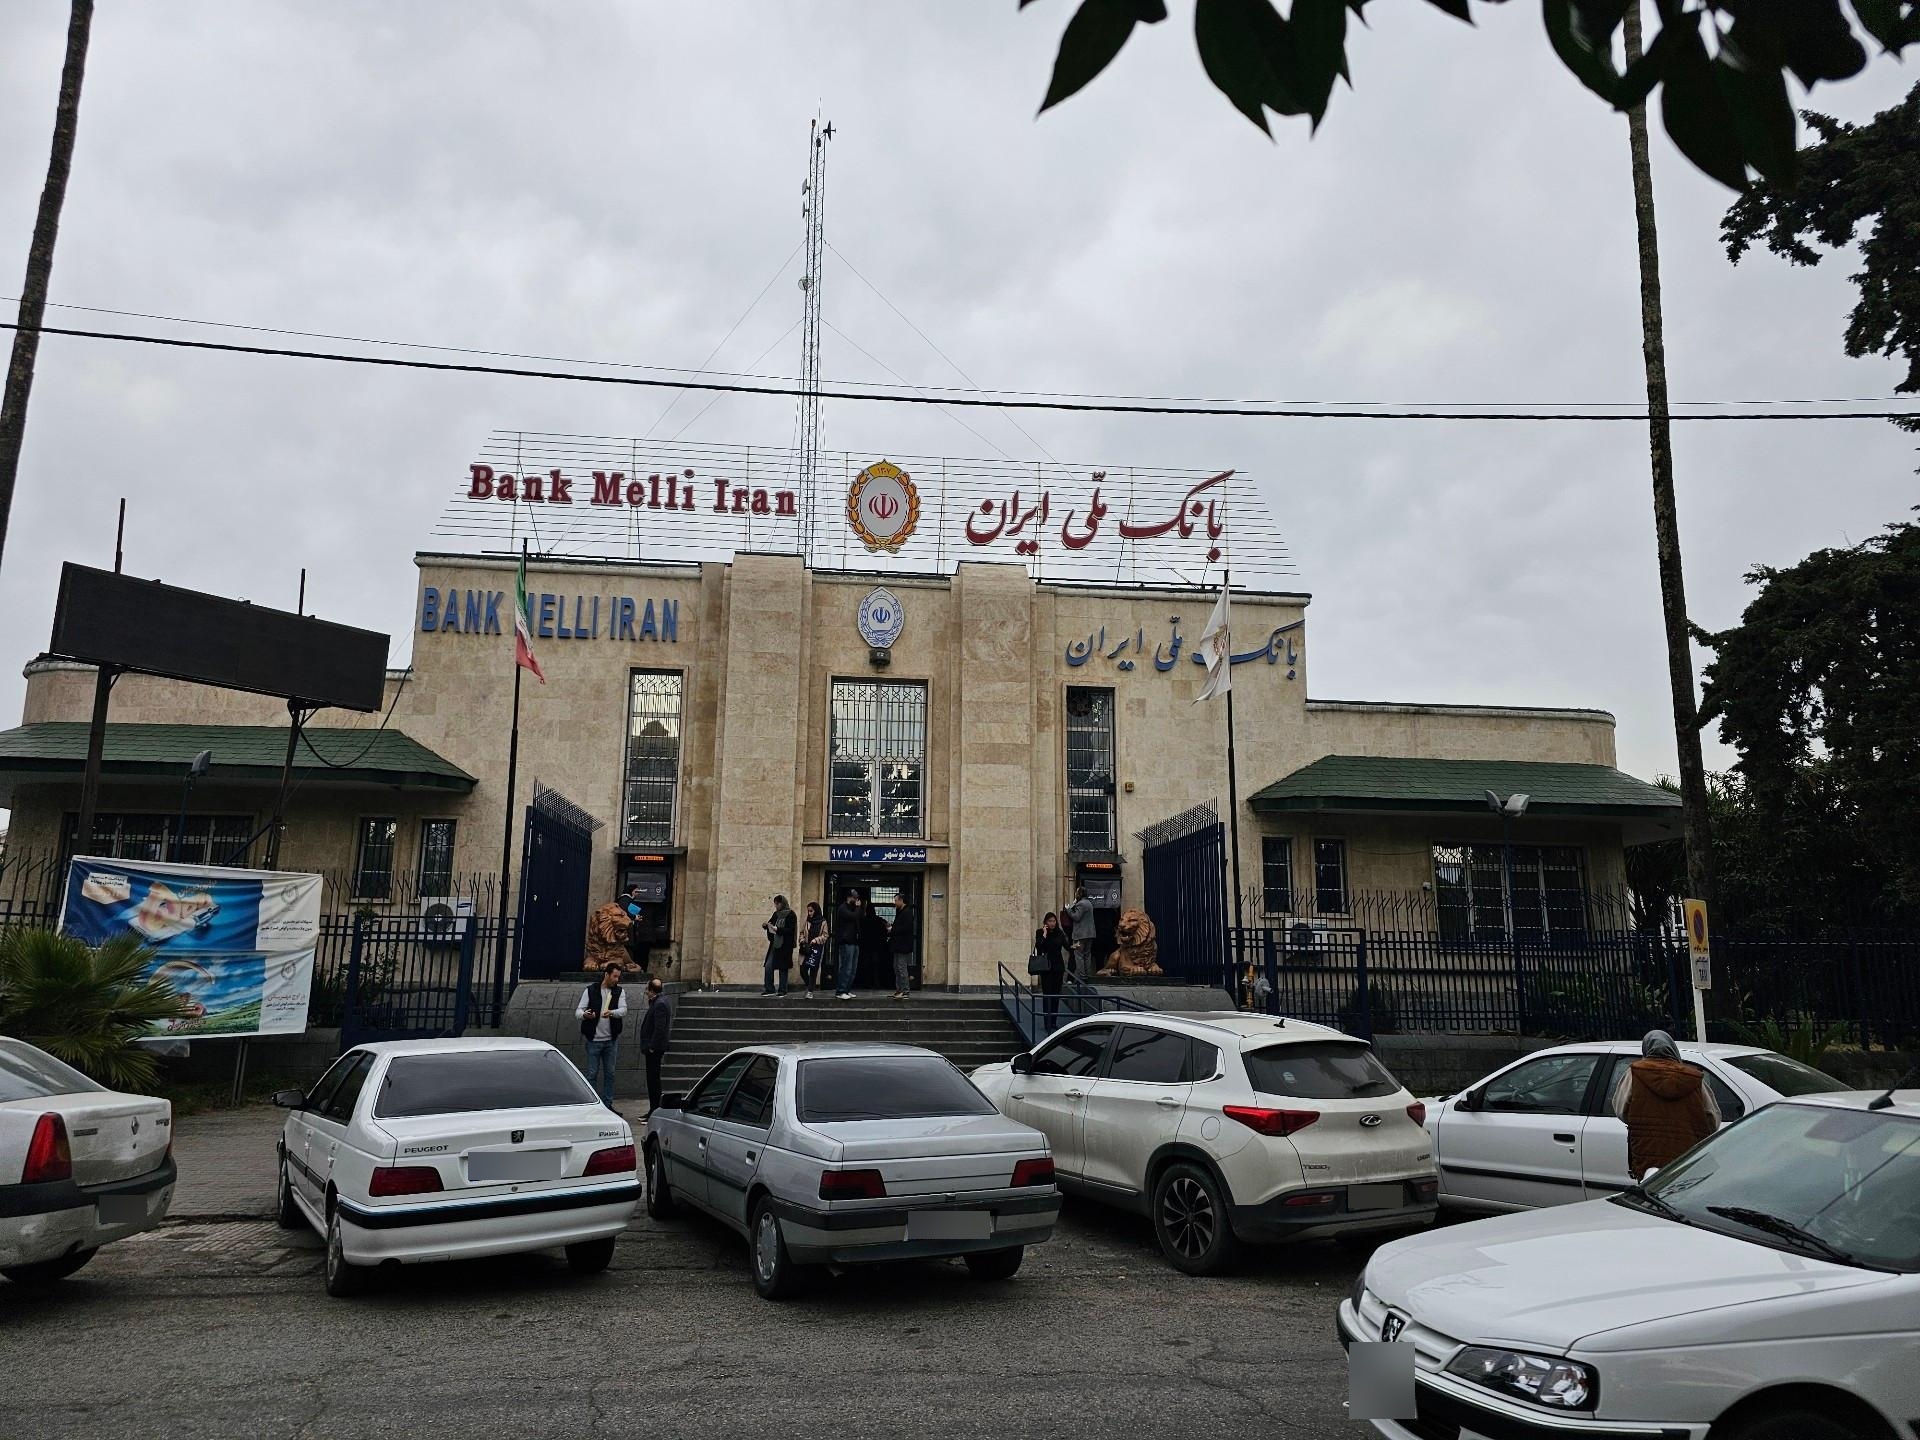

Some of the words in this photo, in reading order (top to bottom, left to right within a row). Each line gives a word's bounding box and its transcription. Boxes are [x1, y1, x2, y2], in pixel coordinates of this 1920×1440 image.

[468, 464, 573, 504] Bank
[590, 468, 695, 511] Melli
[713, 478, 798, 517] Iran
[965, 489, 1050, 555] ایران
[1118, 469, 1236, 562] بانک
[421, 587, 504, 635] BANK
[609, 596, 679, 642] IRAN
[1065, 625, 1143, 672] ایران
[1191, 619, 1305, 680] بانک
[831, 848, 853, 859] ۹۷۷۱
[862, 849, 871, 858] کد
[882, 848, 906, 861] نوشهر
[906, 849, 926, 861] شعبه
[404, 1144, 449, 1154] PEUGEOT
